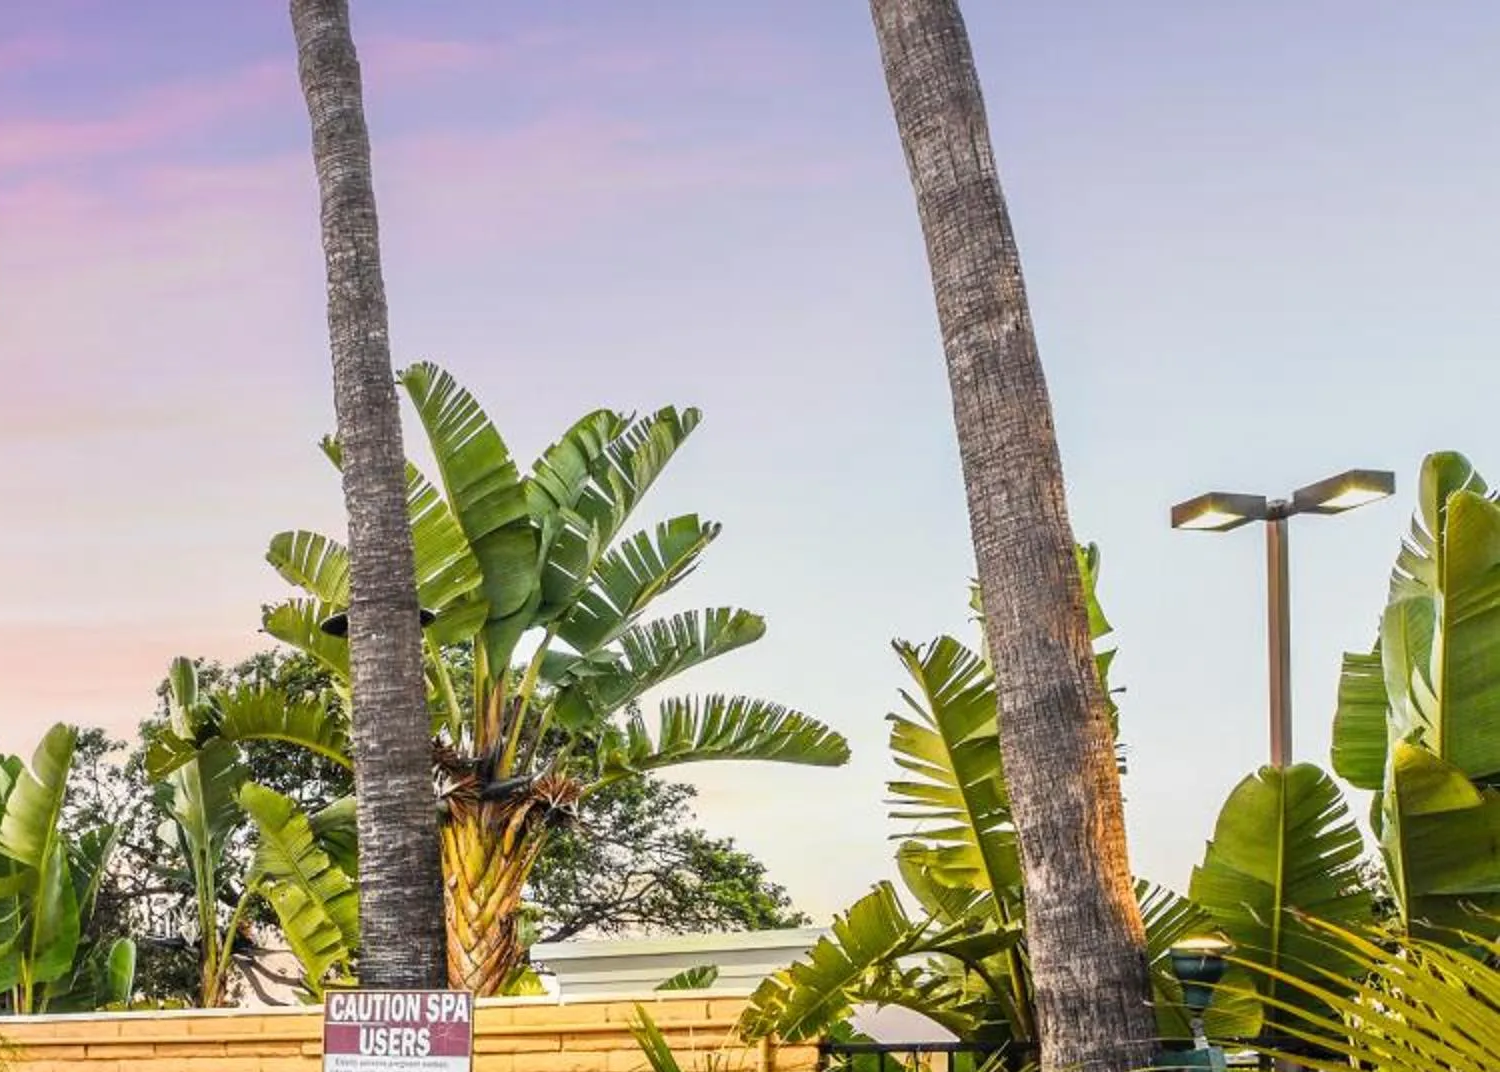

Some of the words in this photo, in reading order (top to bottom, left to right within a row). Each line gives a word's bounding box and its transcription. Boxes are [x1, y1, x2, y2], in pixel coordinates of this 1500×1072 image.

[330, 993, 420, 1021] CAUTION
[426, 994, 469, 1023] SPA
[359, 1027, 431, 1056] USERS
